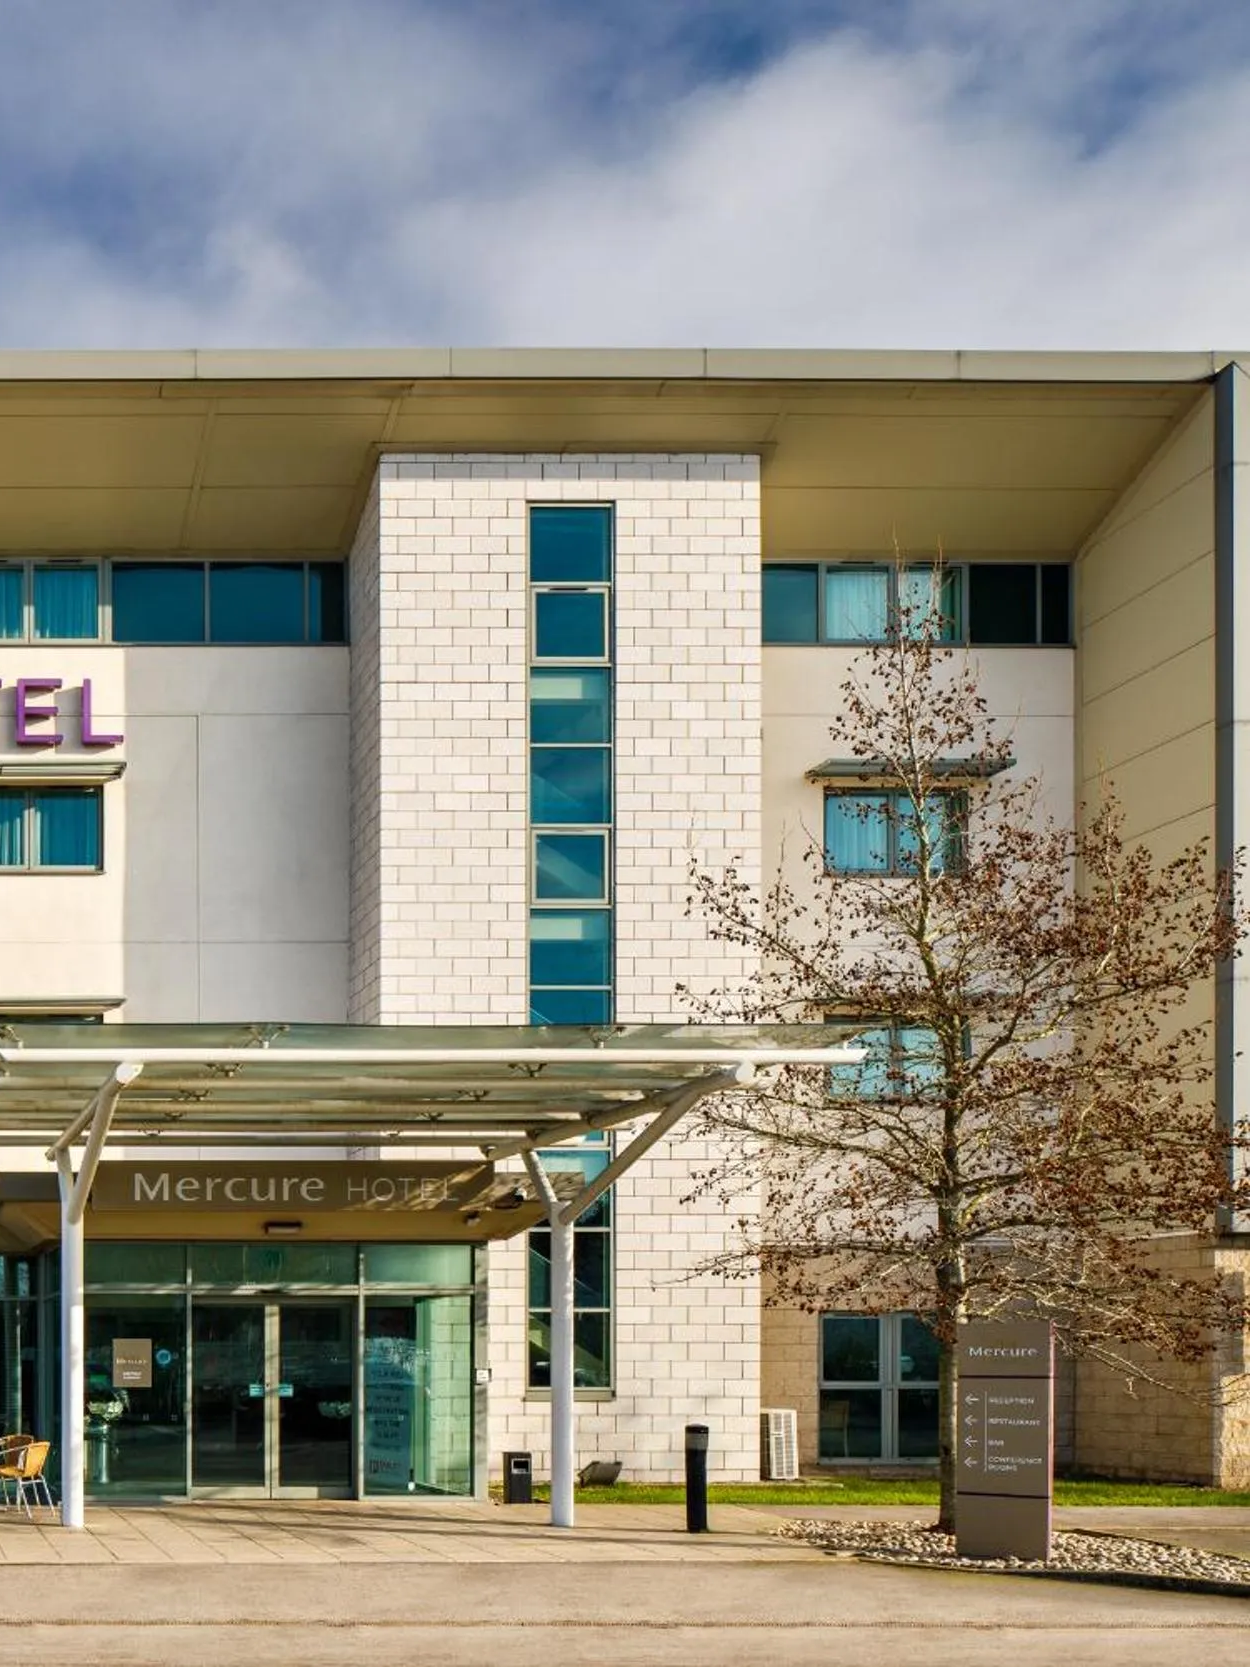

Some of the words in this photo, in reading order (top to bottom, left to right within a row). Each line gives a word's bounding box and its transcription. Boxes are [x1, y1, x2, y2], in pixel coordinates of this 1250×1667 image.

[133, 1172, 325, 1202] Mercure
[346, 1177, 460, 1202] HOTEL
[968, 1346, 1039, 1357] Mercure
